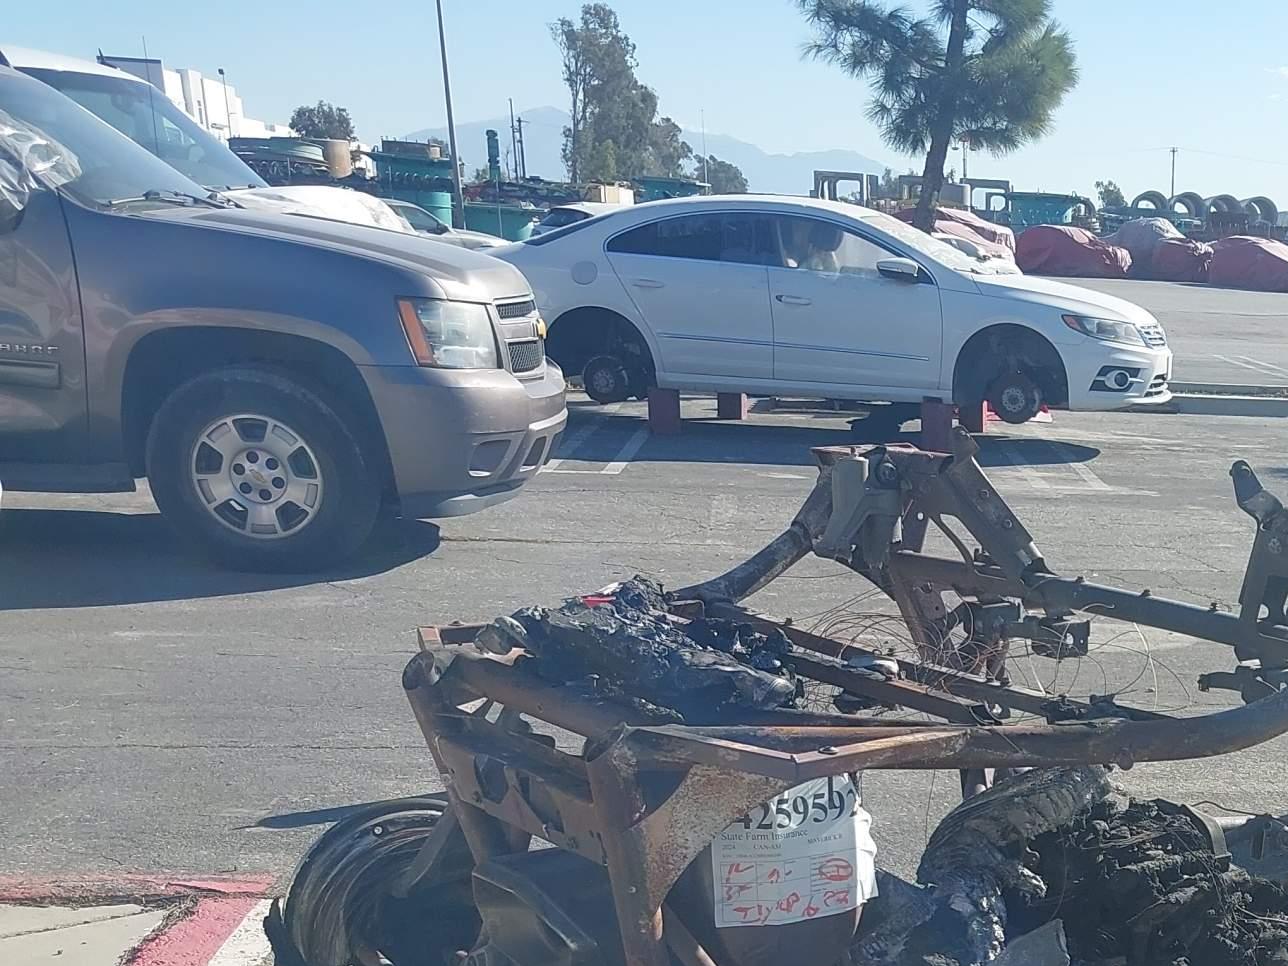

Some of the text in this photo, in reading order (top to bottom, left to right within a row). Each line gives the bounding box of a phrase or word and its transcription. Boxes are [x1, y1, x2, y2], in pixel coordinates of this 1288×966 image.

[721, 828, 808, 841] State Farm Insurance
